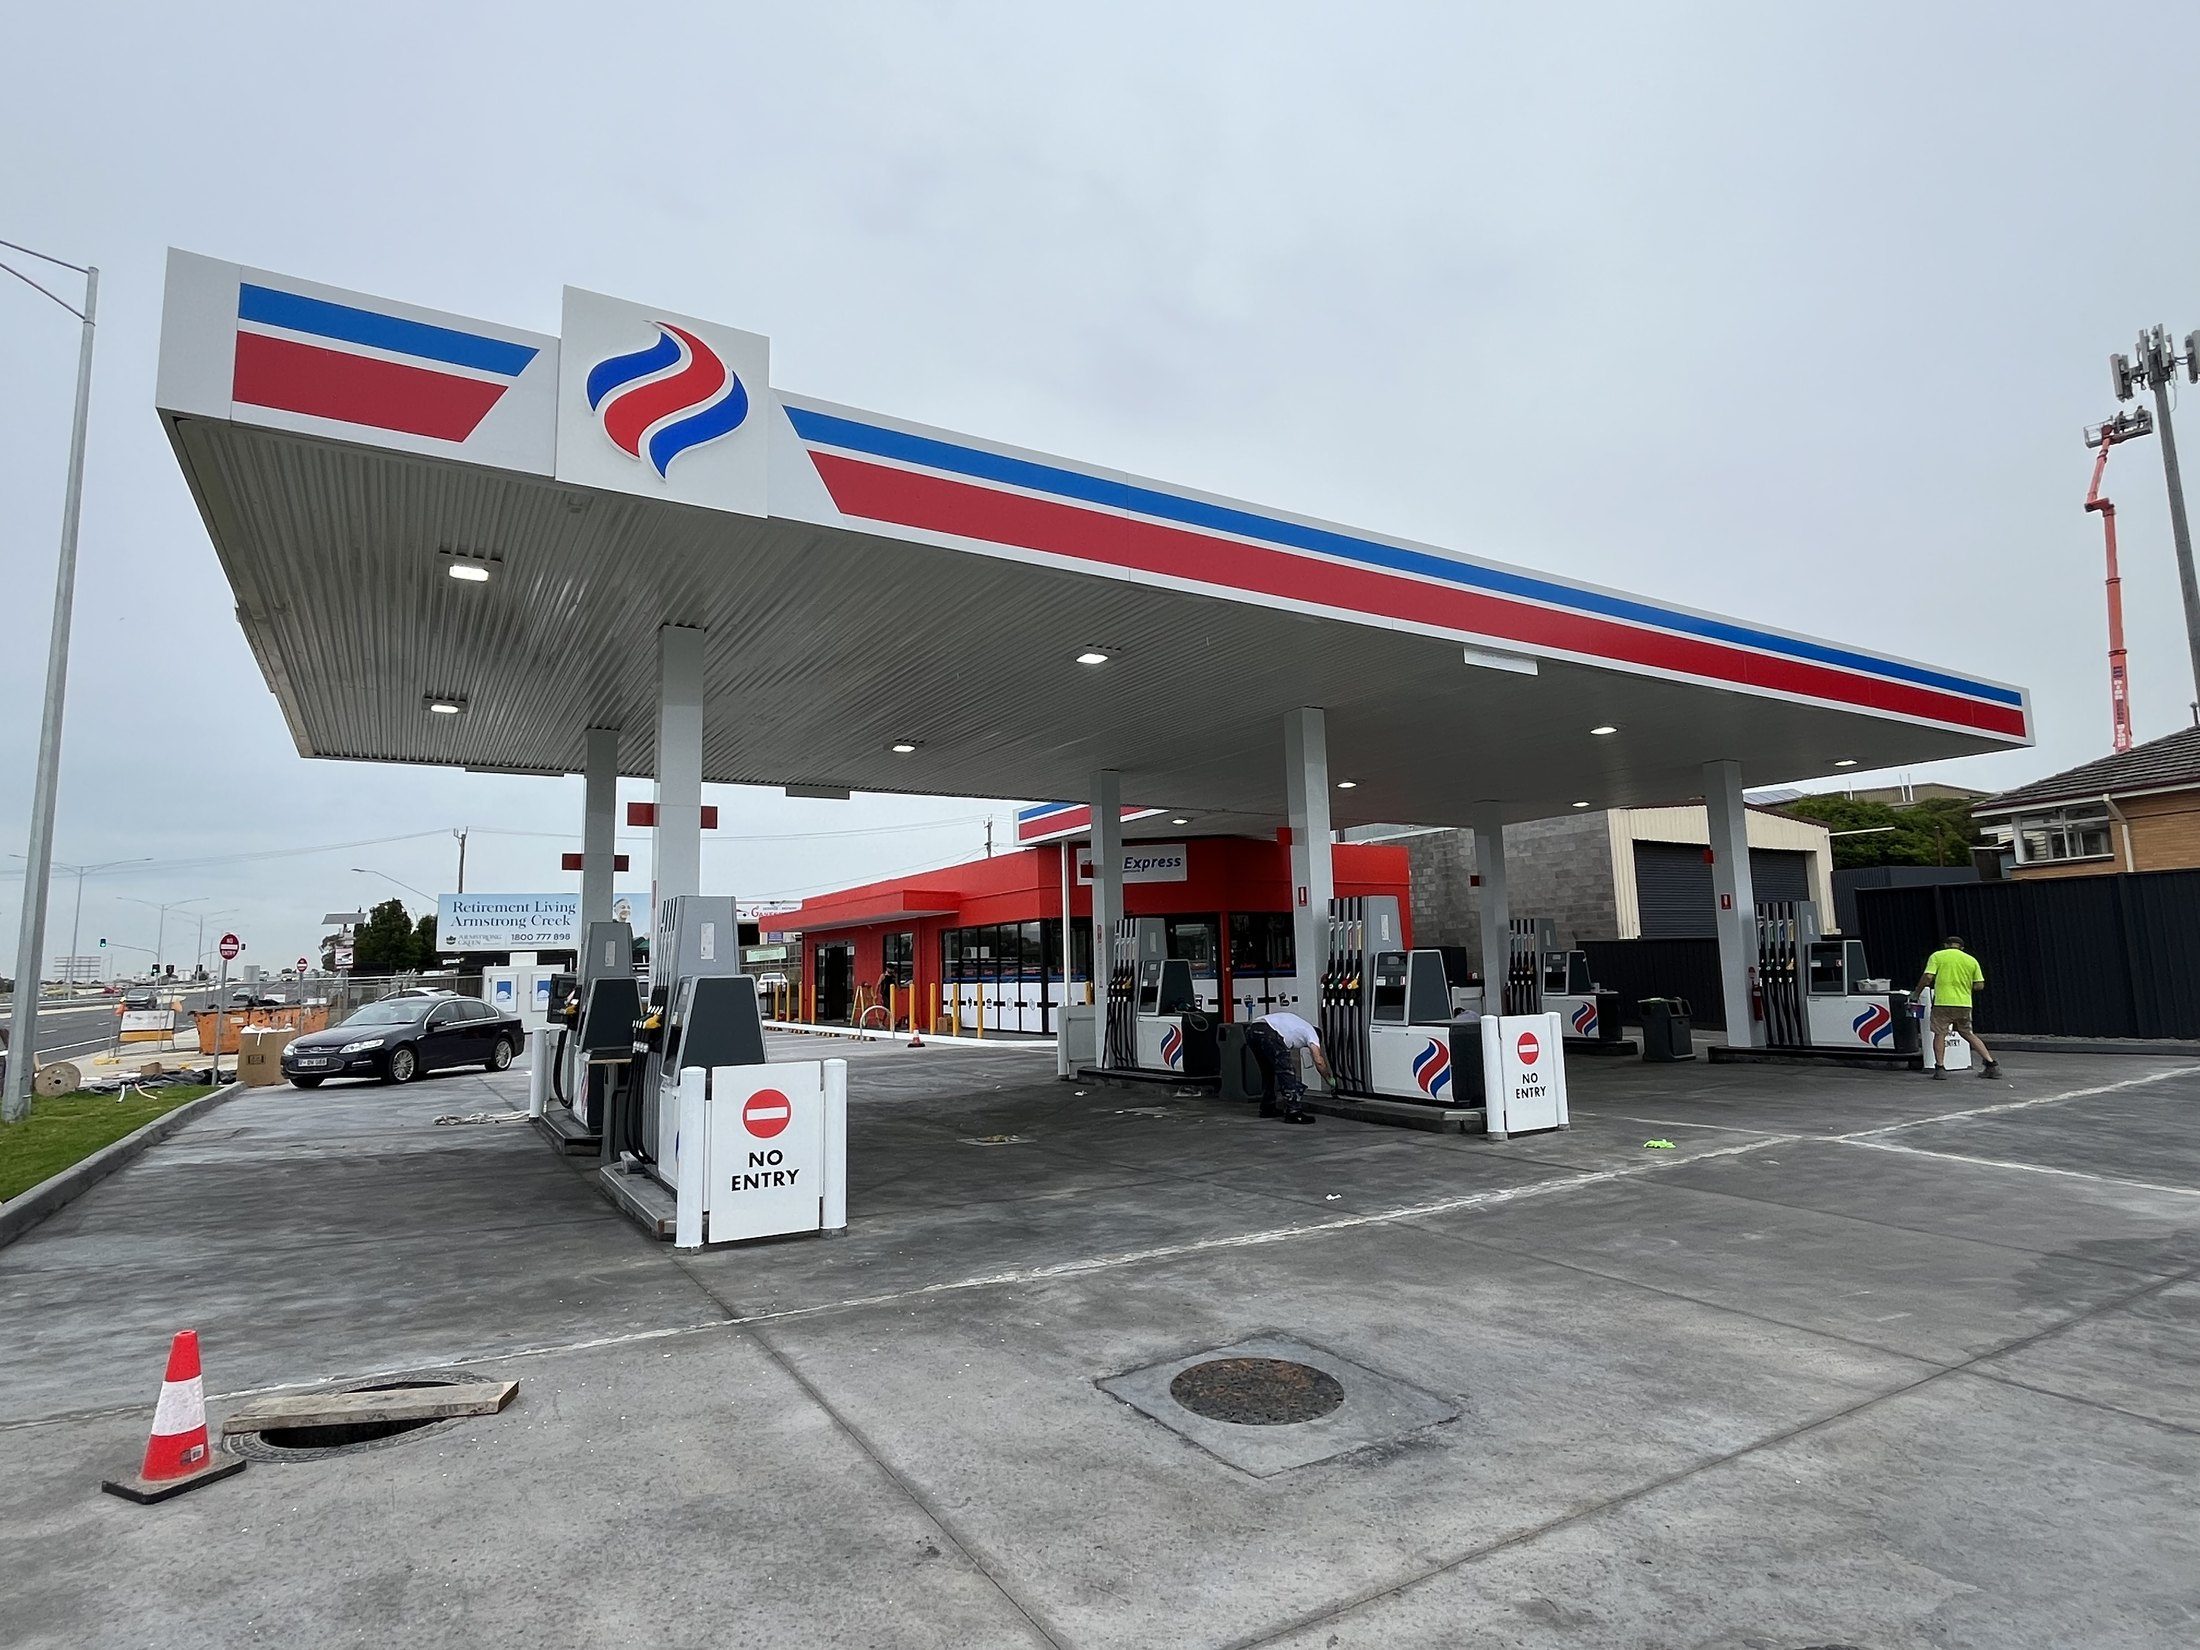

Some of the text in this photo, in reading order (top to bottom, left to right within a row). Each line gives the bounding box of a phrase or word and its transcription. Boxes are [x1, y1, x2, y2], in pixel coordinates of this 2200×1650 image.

[1123, 857, 1181, 872] Express
[453, 901, 577, 915] Retirement Living
[451, 914, 571, 929] Armstrong Creek
[511, 933, 571, 941] 1800 777 898
[1522, 1072, 1538, 1084] NO
[1515, 1086, 1547, 1099] ENTRY
[748, 1149, 784, 1168] NO
[731, 1168, 800, 1192] ENTRY
